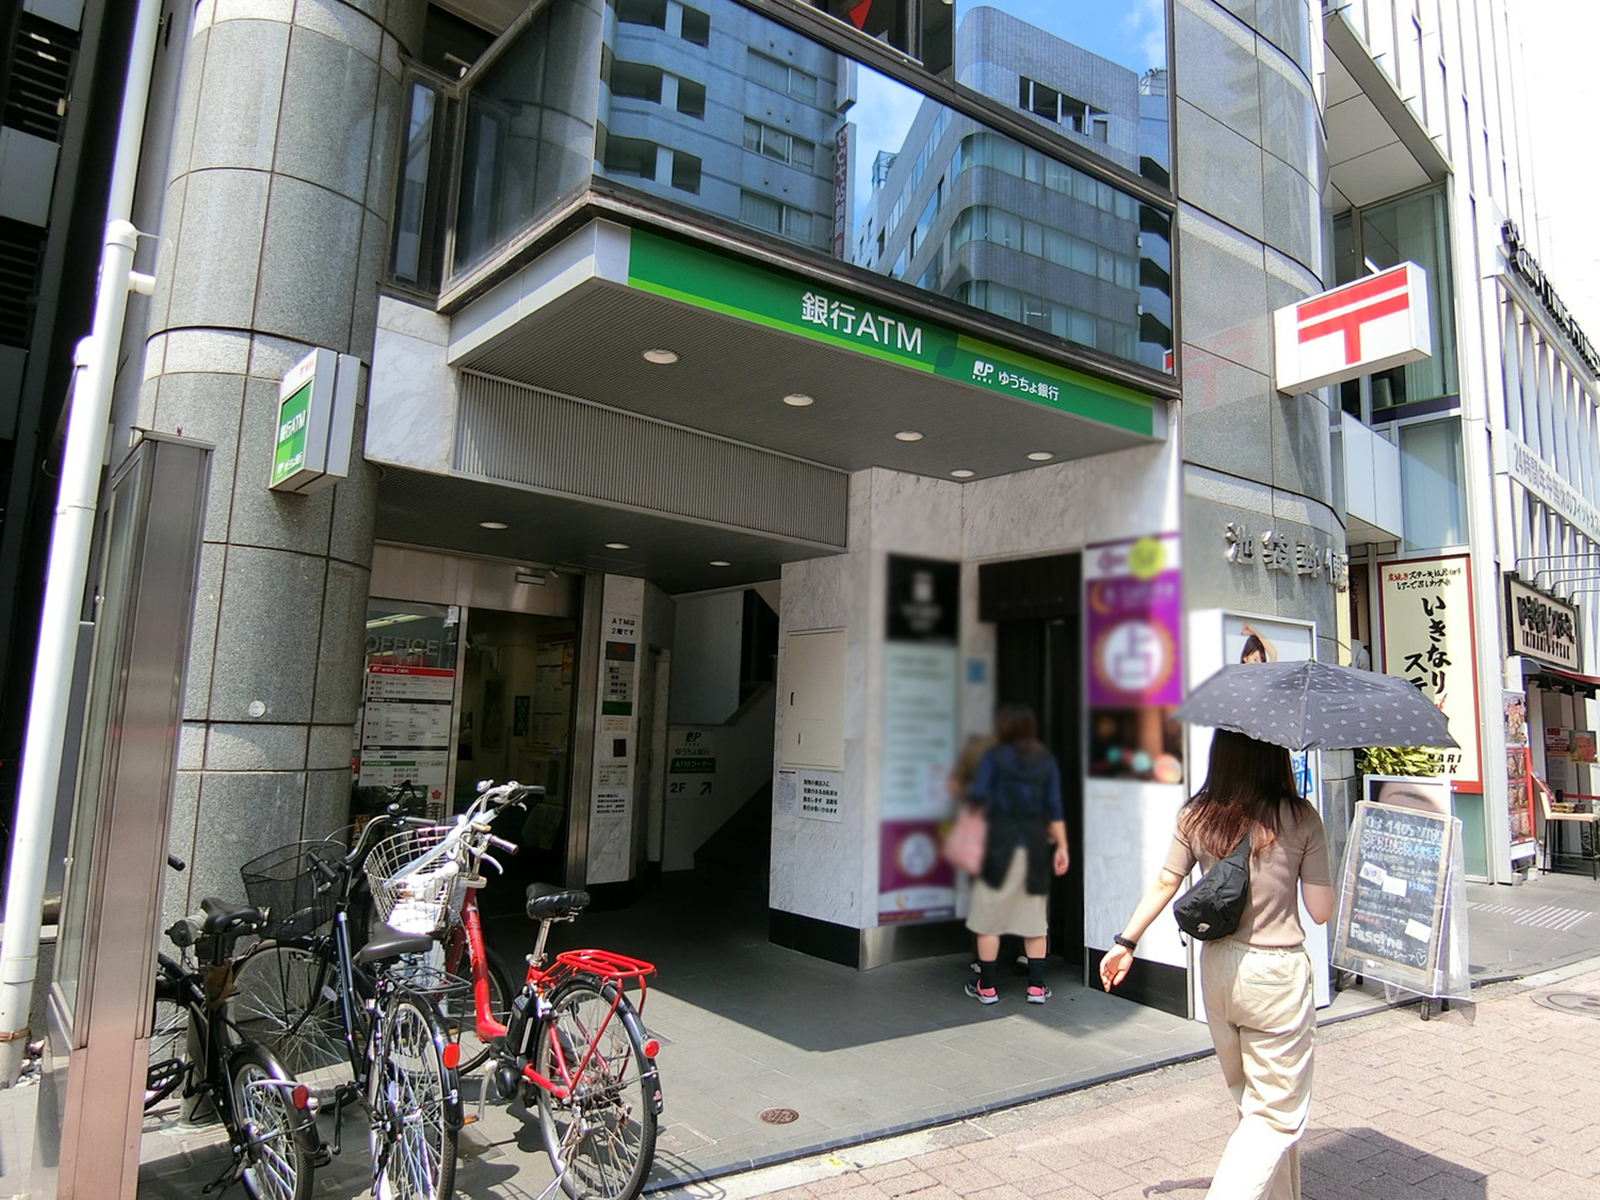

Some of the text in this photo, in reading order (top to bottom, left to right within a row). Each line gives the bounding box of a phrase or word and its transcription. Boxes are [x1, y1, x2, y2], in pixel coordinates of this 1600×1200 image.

[801, 291, 923, 355] 銀行ATM
[998, 371, 1060, 402] ゆうちょ銀行
[612, 617, 635, 627] ATMは
[670, 781, 686, 794] 2F
